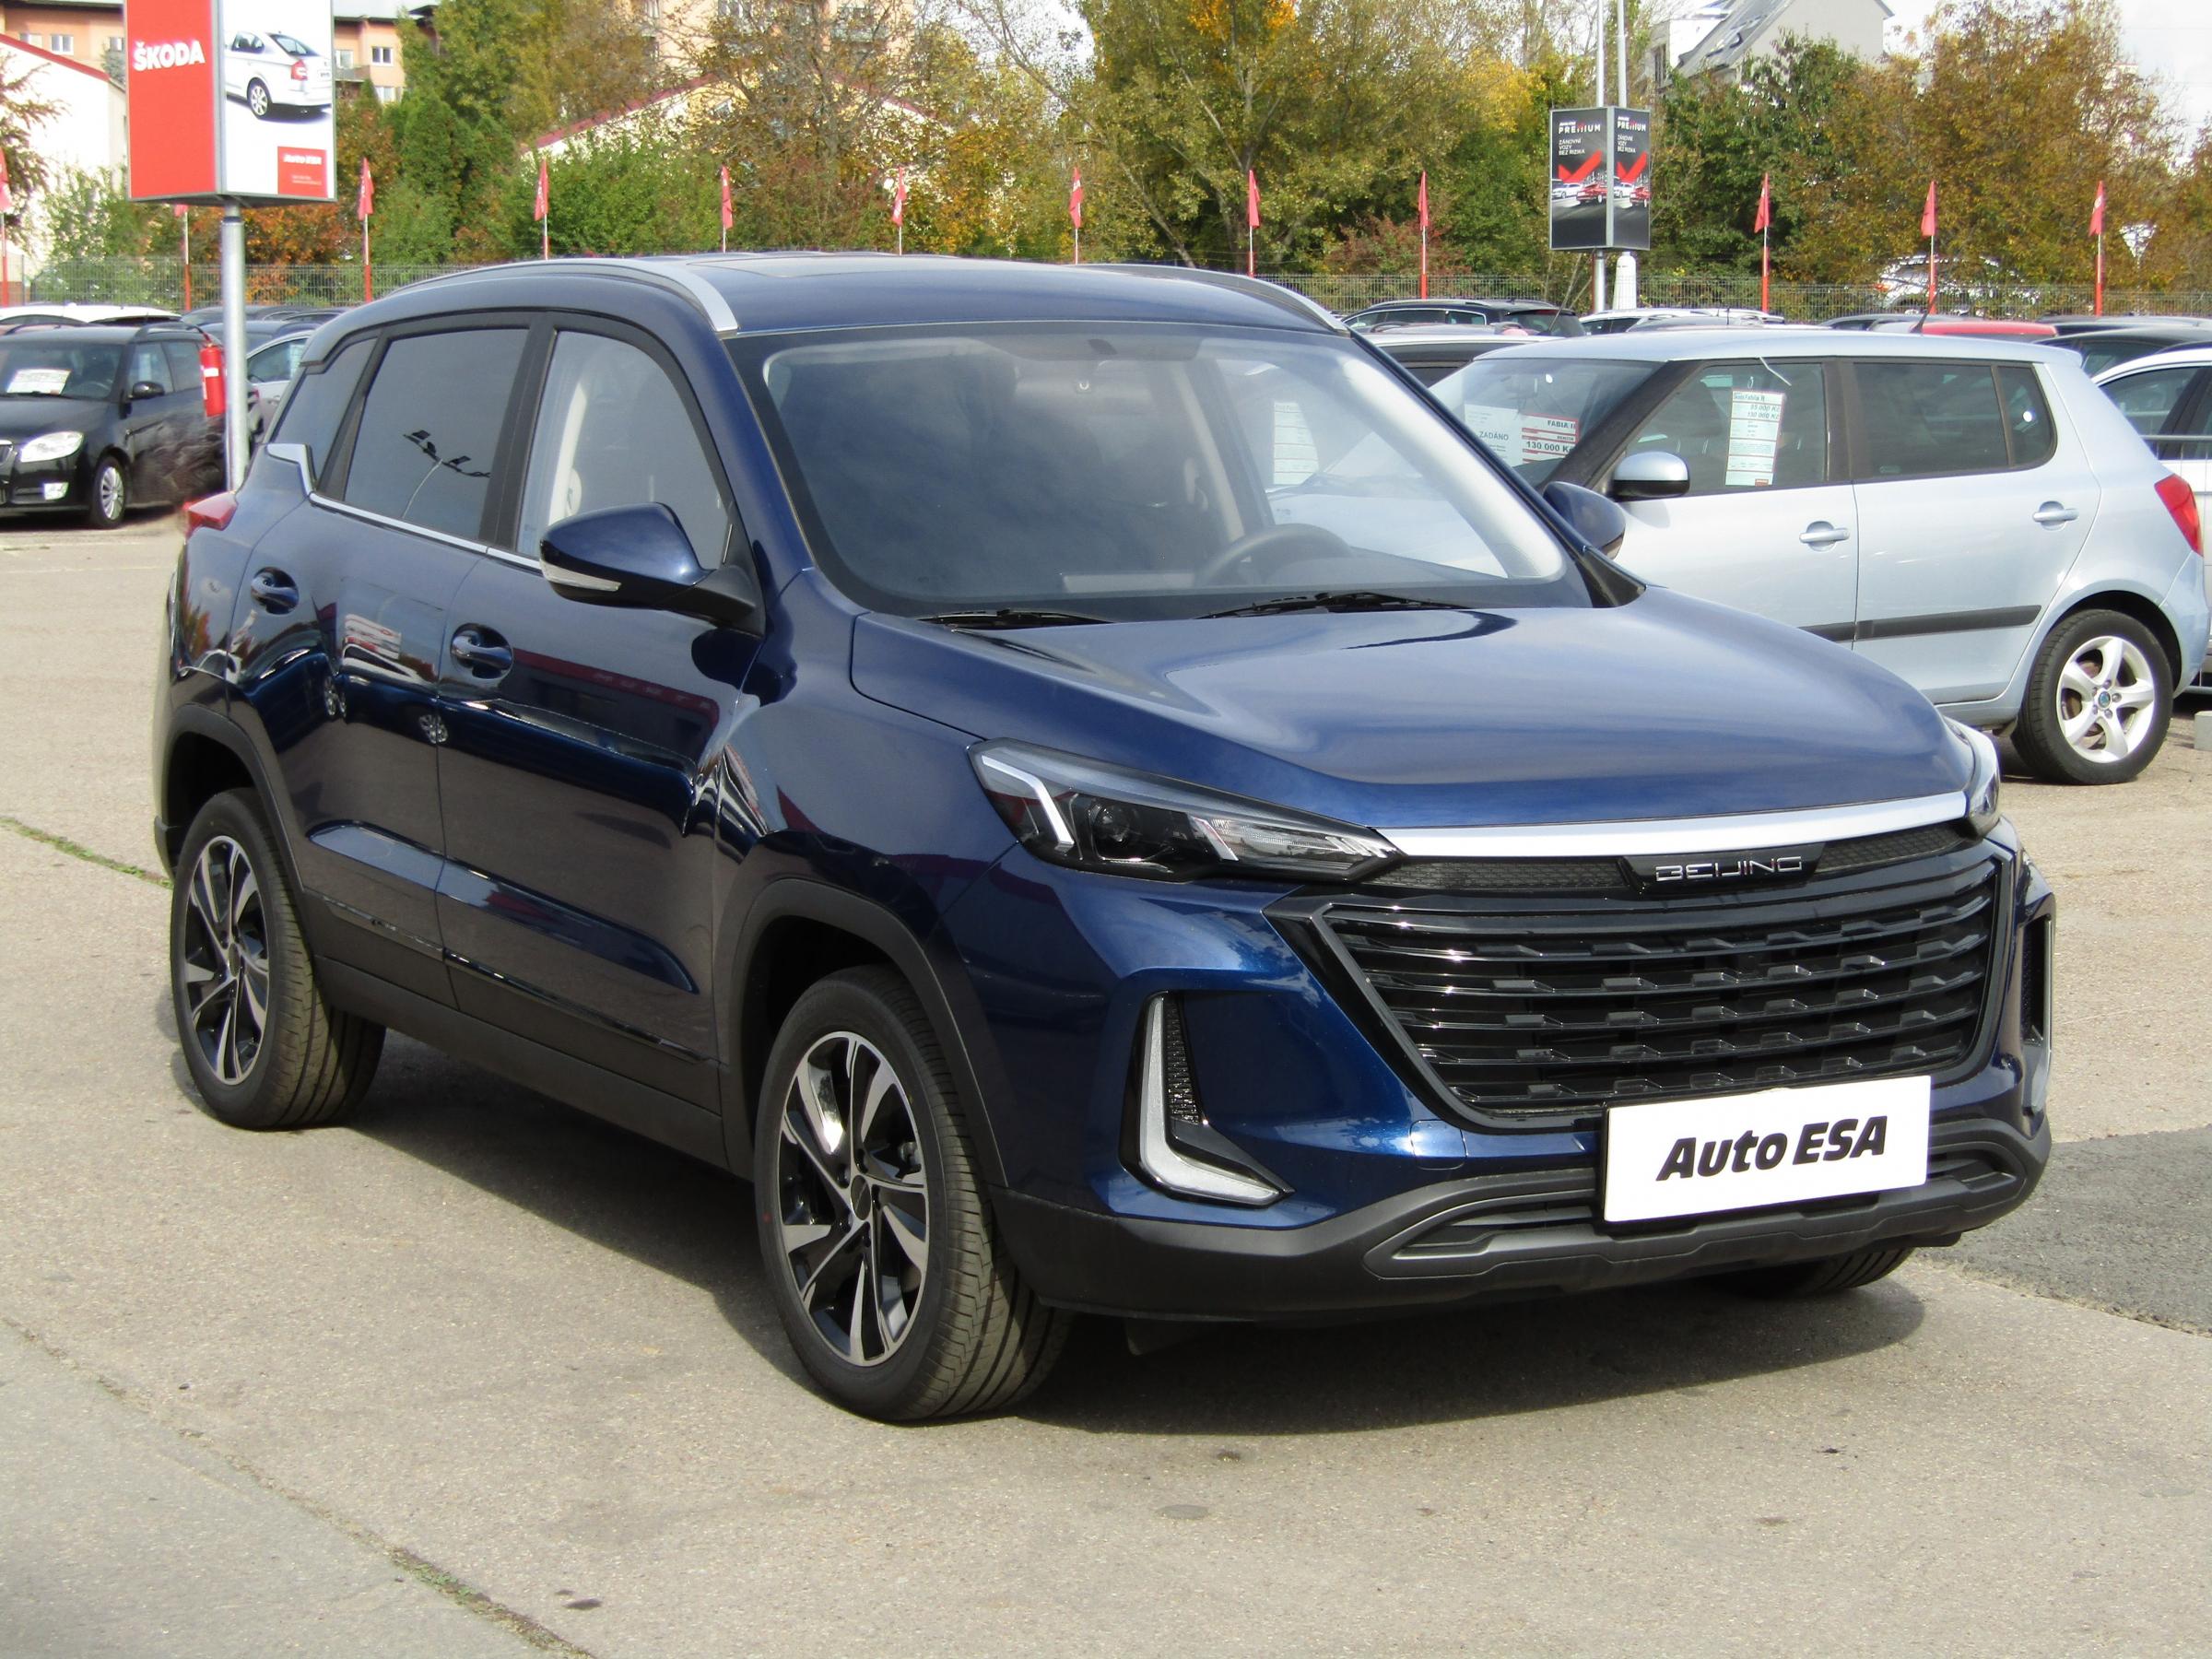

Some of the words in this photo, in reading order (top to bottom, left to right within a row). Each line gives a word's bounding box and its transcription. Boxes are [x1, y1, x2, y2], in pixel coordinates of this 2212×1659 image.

[133, 40, 206, 71] ŠKODA
[1559, 123, 1601, 135] PREMIUM
[1618, 121, 1646, 132] PREMIUM
[1547, 419, 1569, 429] FABIA
[1478, 430, 1509, 441] ZADÁNO
[1526, 441, 1542, 450] 130
[1544, 443, 1560, 452] 000
[1655, 1130, 1788, 1182] Auto
[1793, 1115, 1888, 1166] ESA
